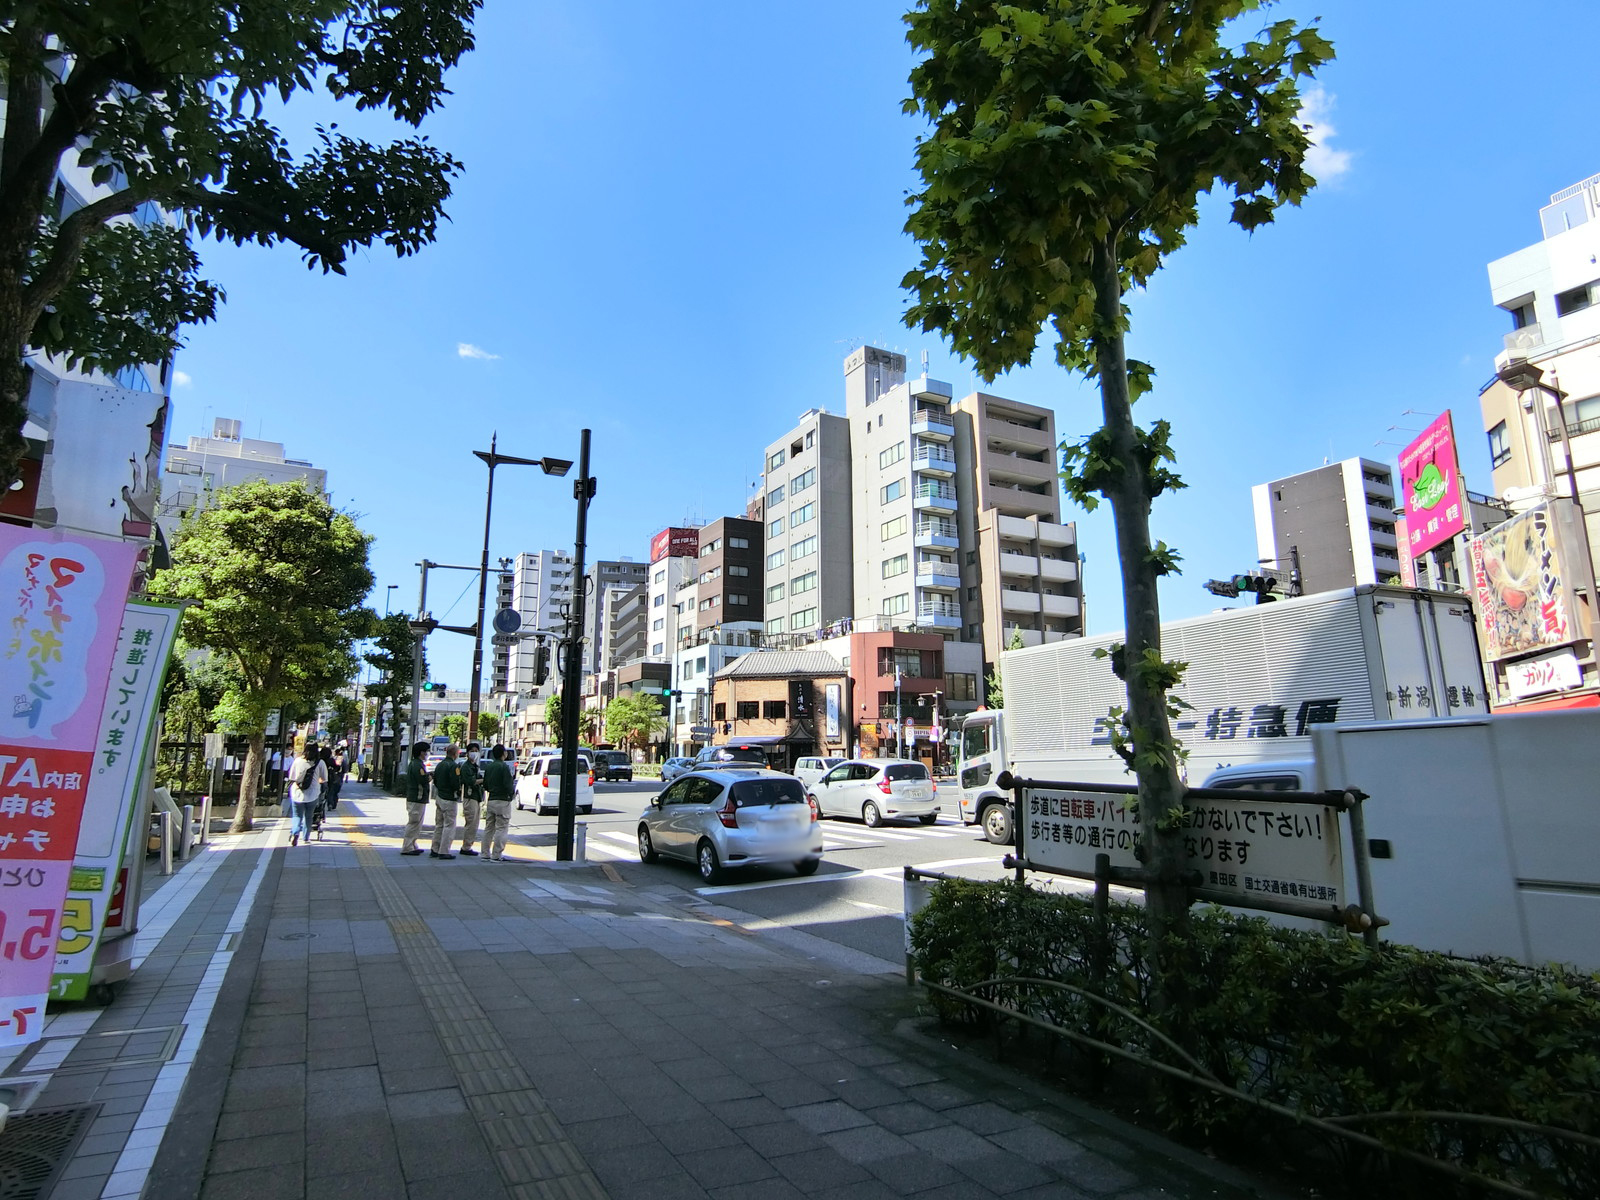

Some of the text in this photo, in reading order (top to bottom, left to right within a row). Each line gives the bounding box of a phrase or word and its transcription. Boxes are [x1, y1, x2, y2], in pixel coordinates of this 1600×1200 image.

[1533, 511, 1557, 596] ラーメン
[1523, 660, 1555, 686] ガツン
[1209, 871, 1337, 902] 墨田区 国土交通省亀有出張所
